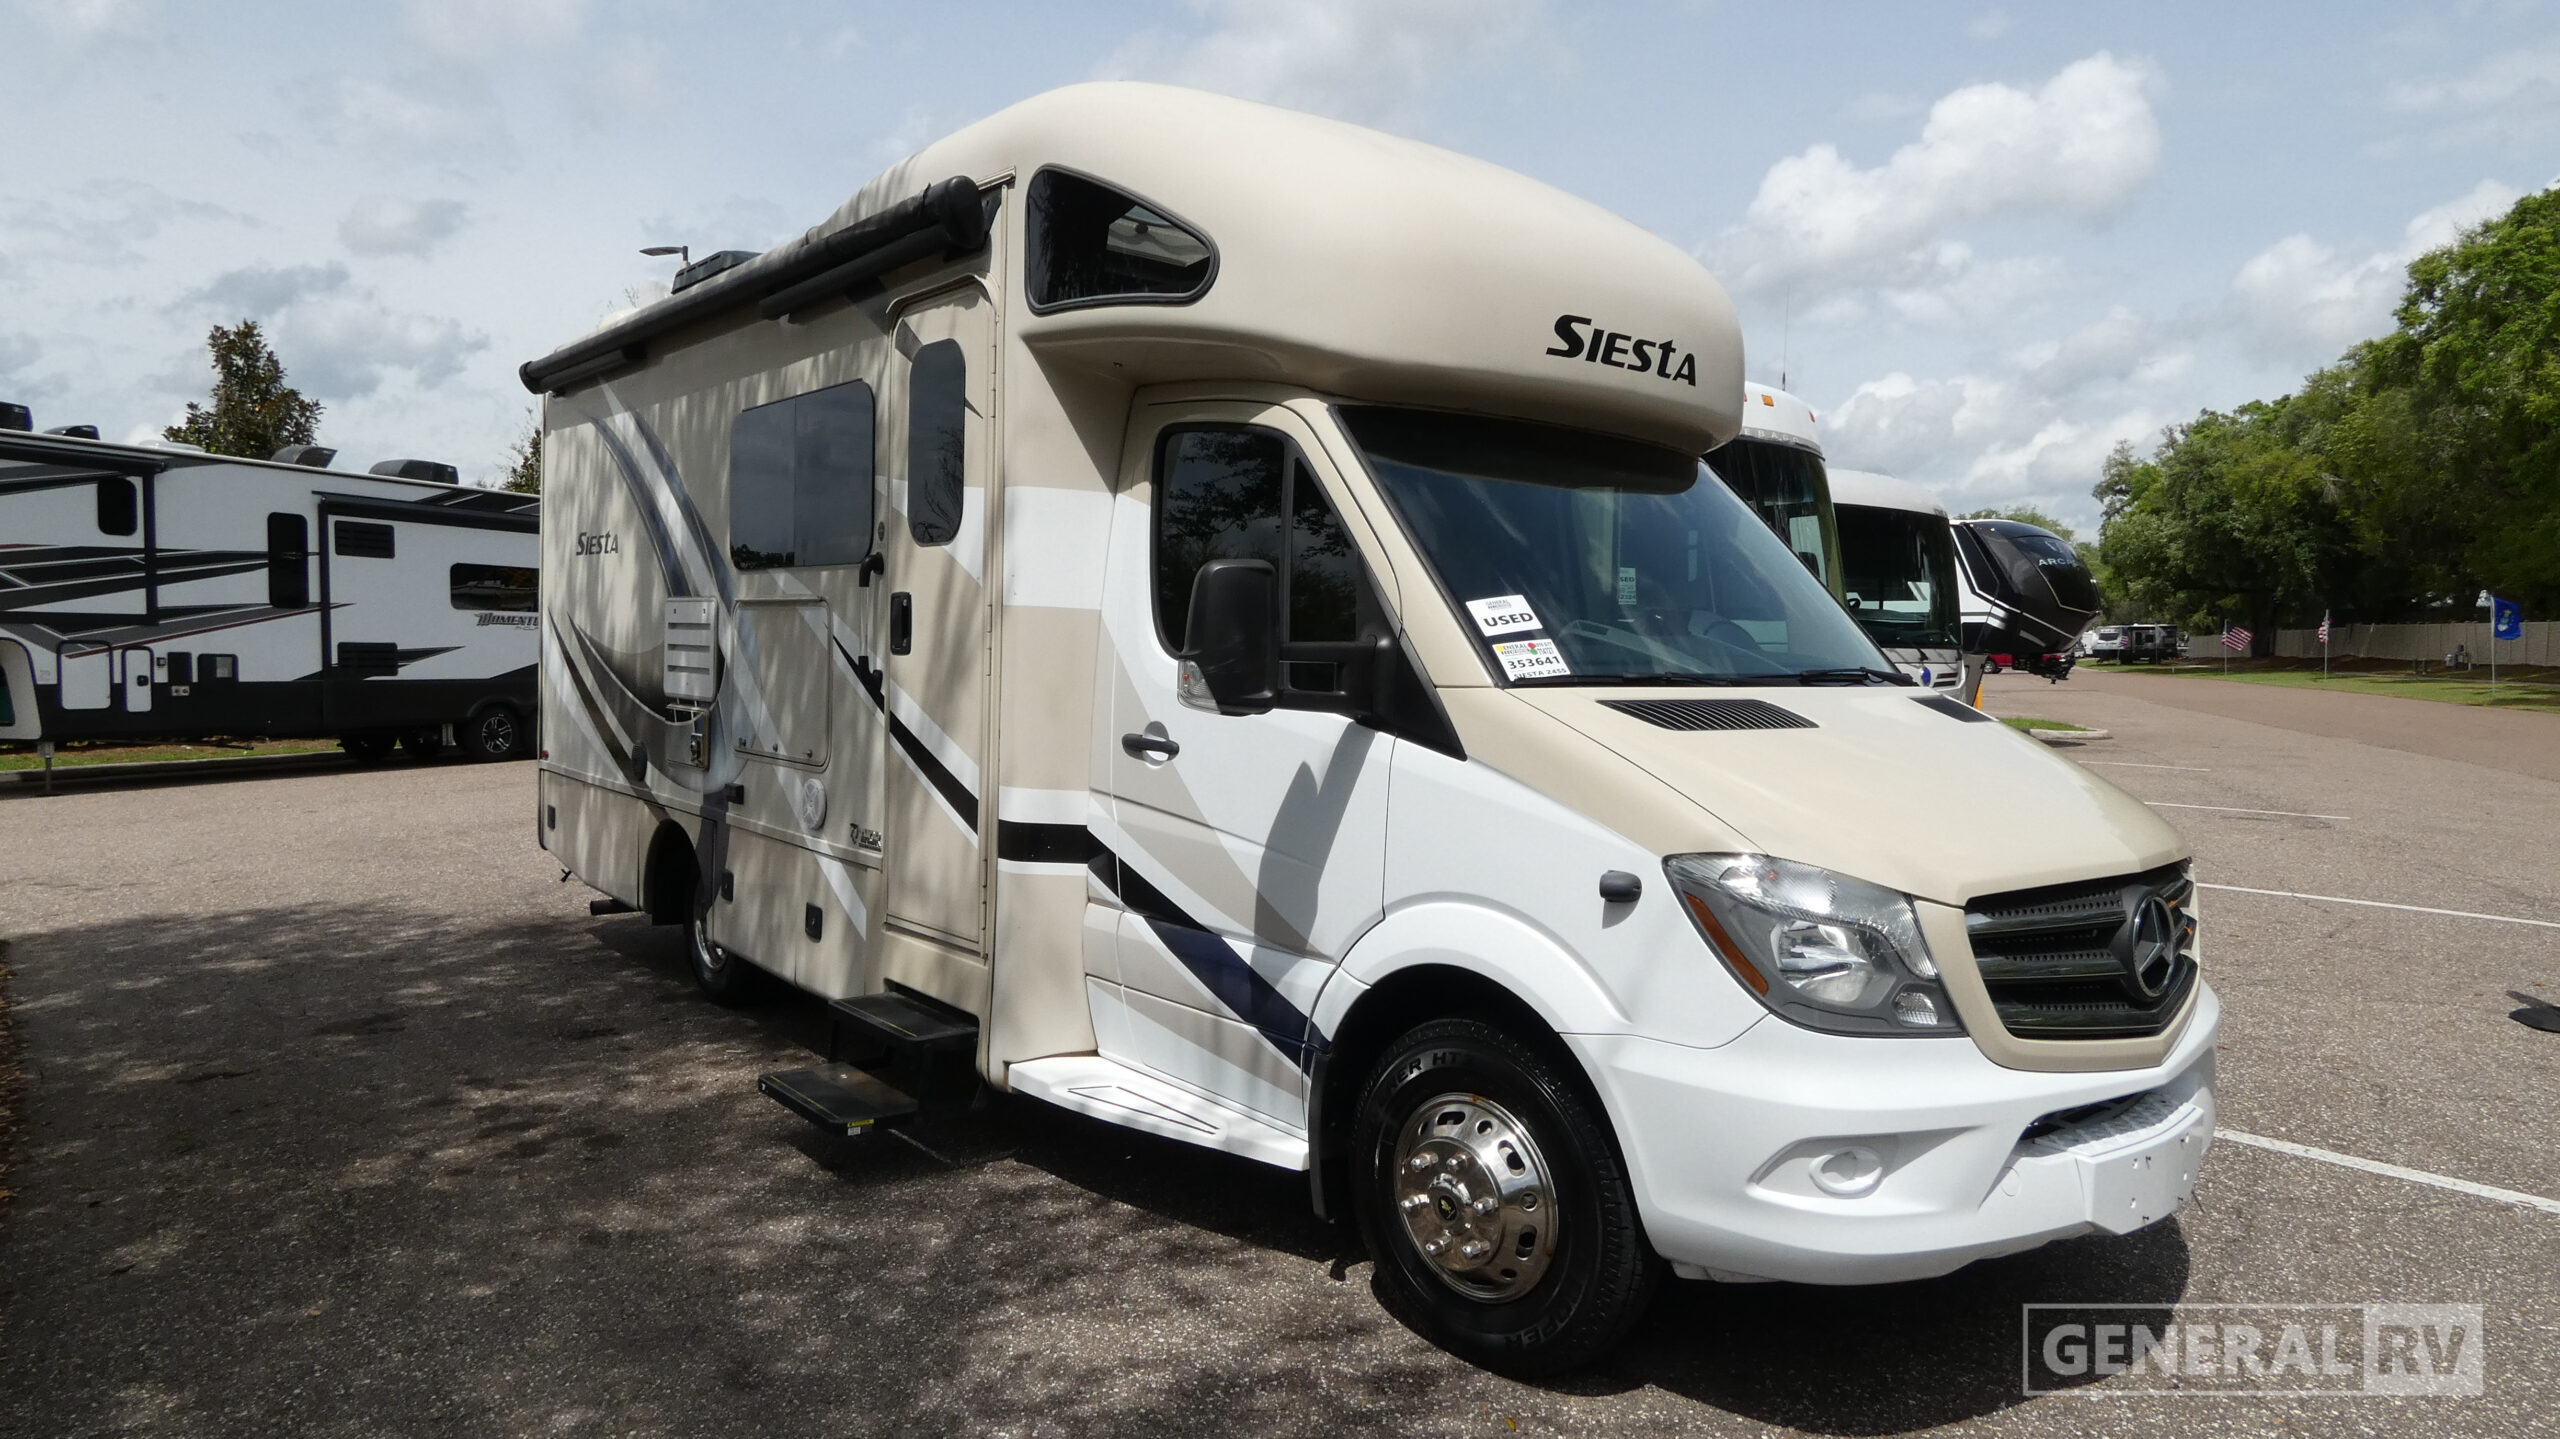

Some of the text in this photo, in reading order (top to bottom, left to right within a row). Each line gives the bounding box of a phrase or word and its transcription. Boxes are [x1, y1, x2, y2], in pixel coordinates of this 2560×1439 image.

[1483, 612, 1534, 627] USED
[1500, 642, 1528, 651] ENERAL
[1507, 656, 1561, 670] 353641
